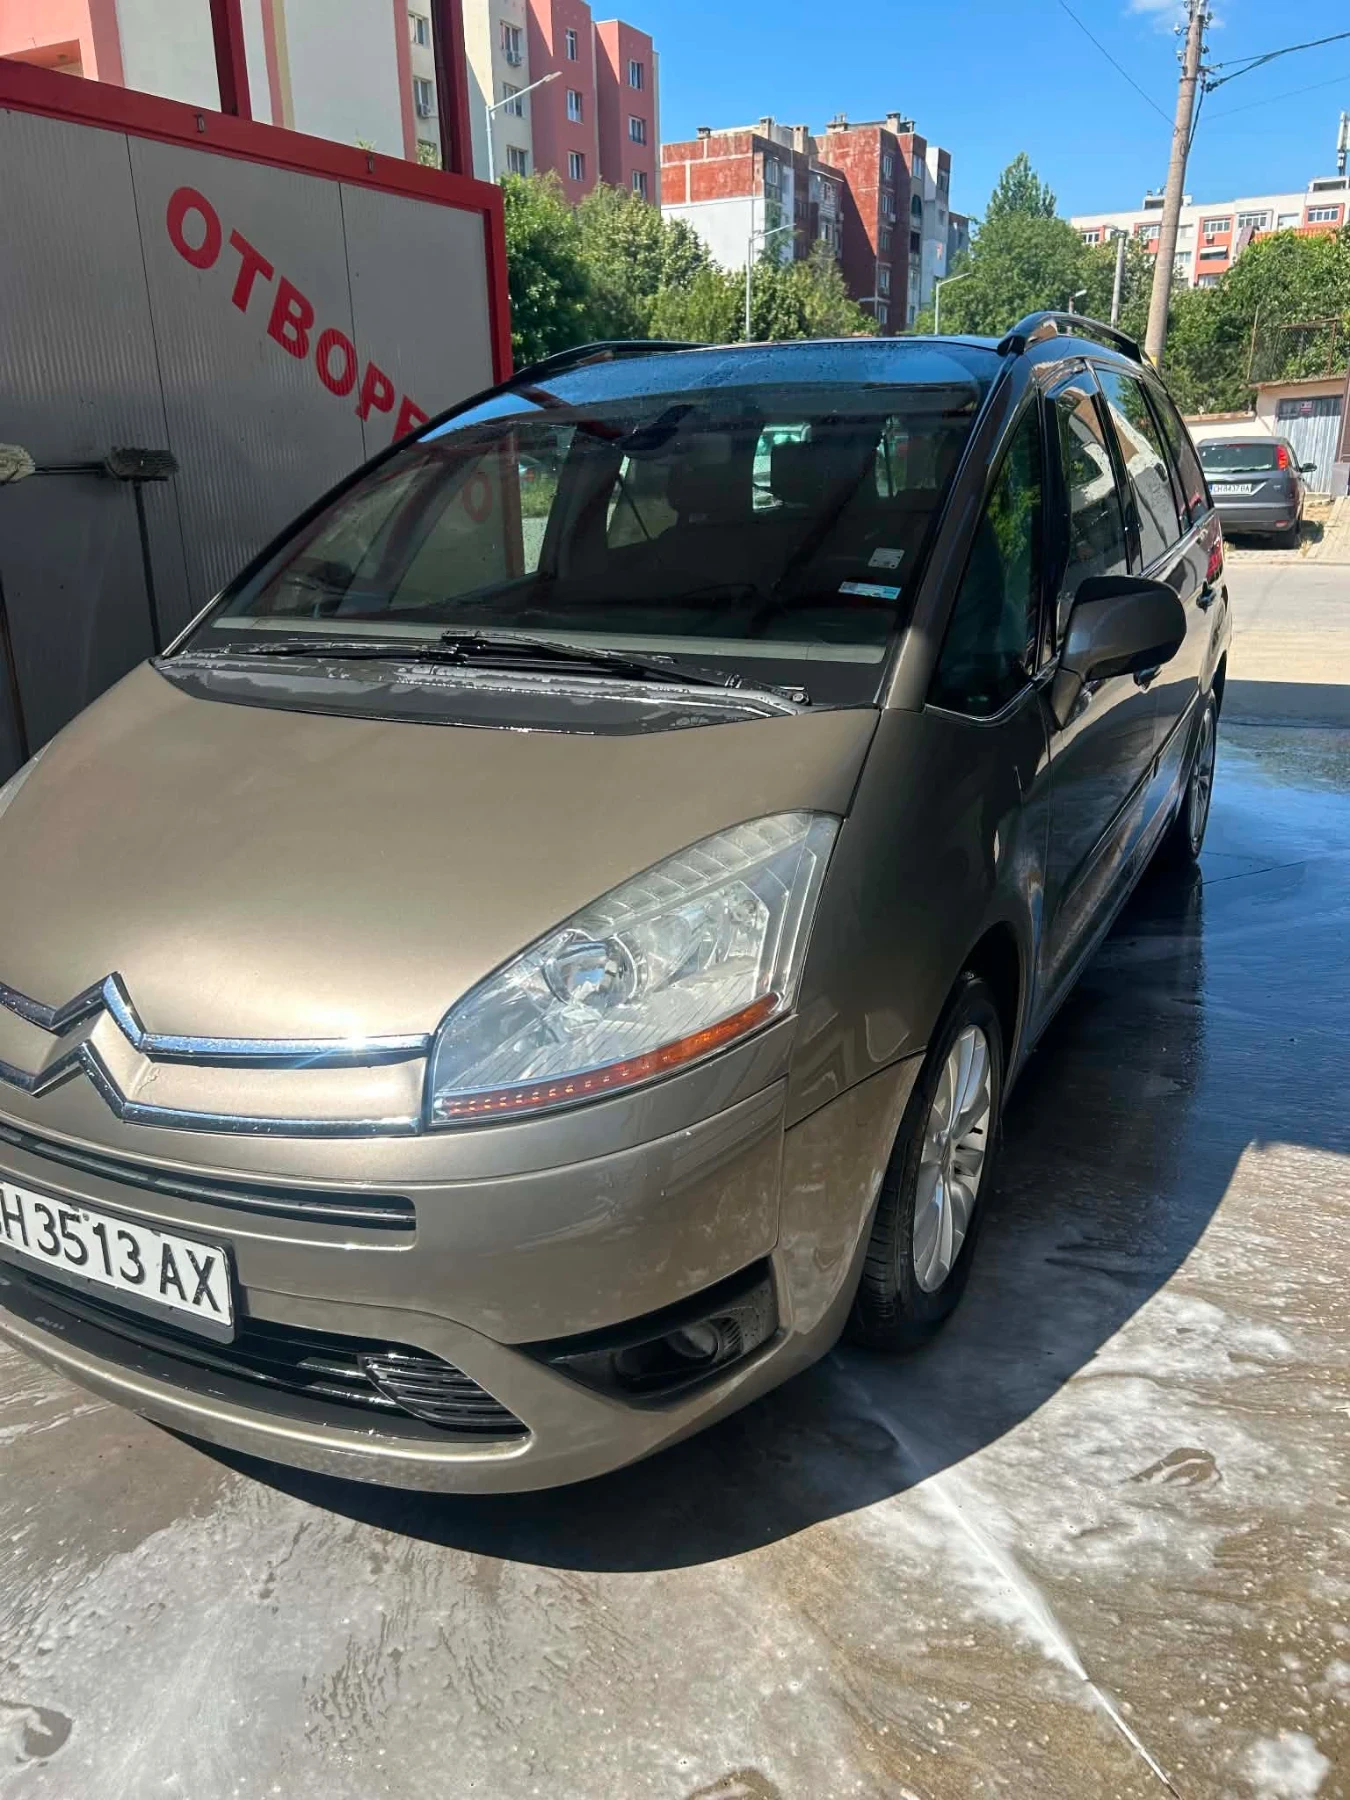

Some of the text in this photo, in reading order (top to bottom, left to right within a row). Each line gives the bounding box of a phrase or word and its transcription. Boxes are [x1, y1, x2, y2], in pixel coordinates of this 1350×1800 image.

[0, 1189, 221, 1312] H 3513 AX
